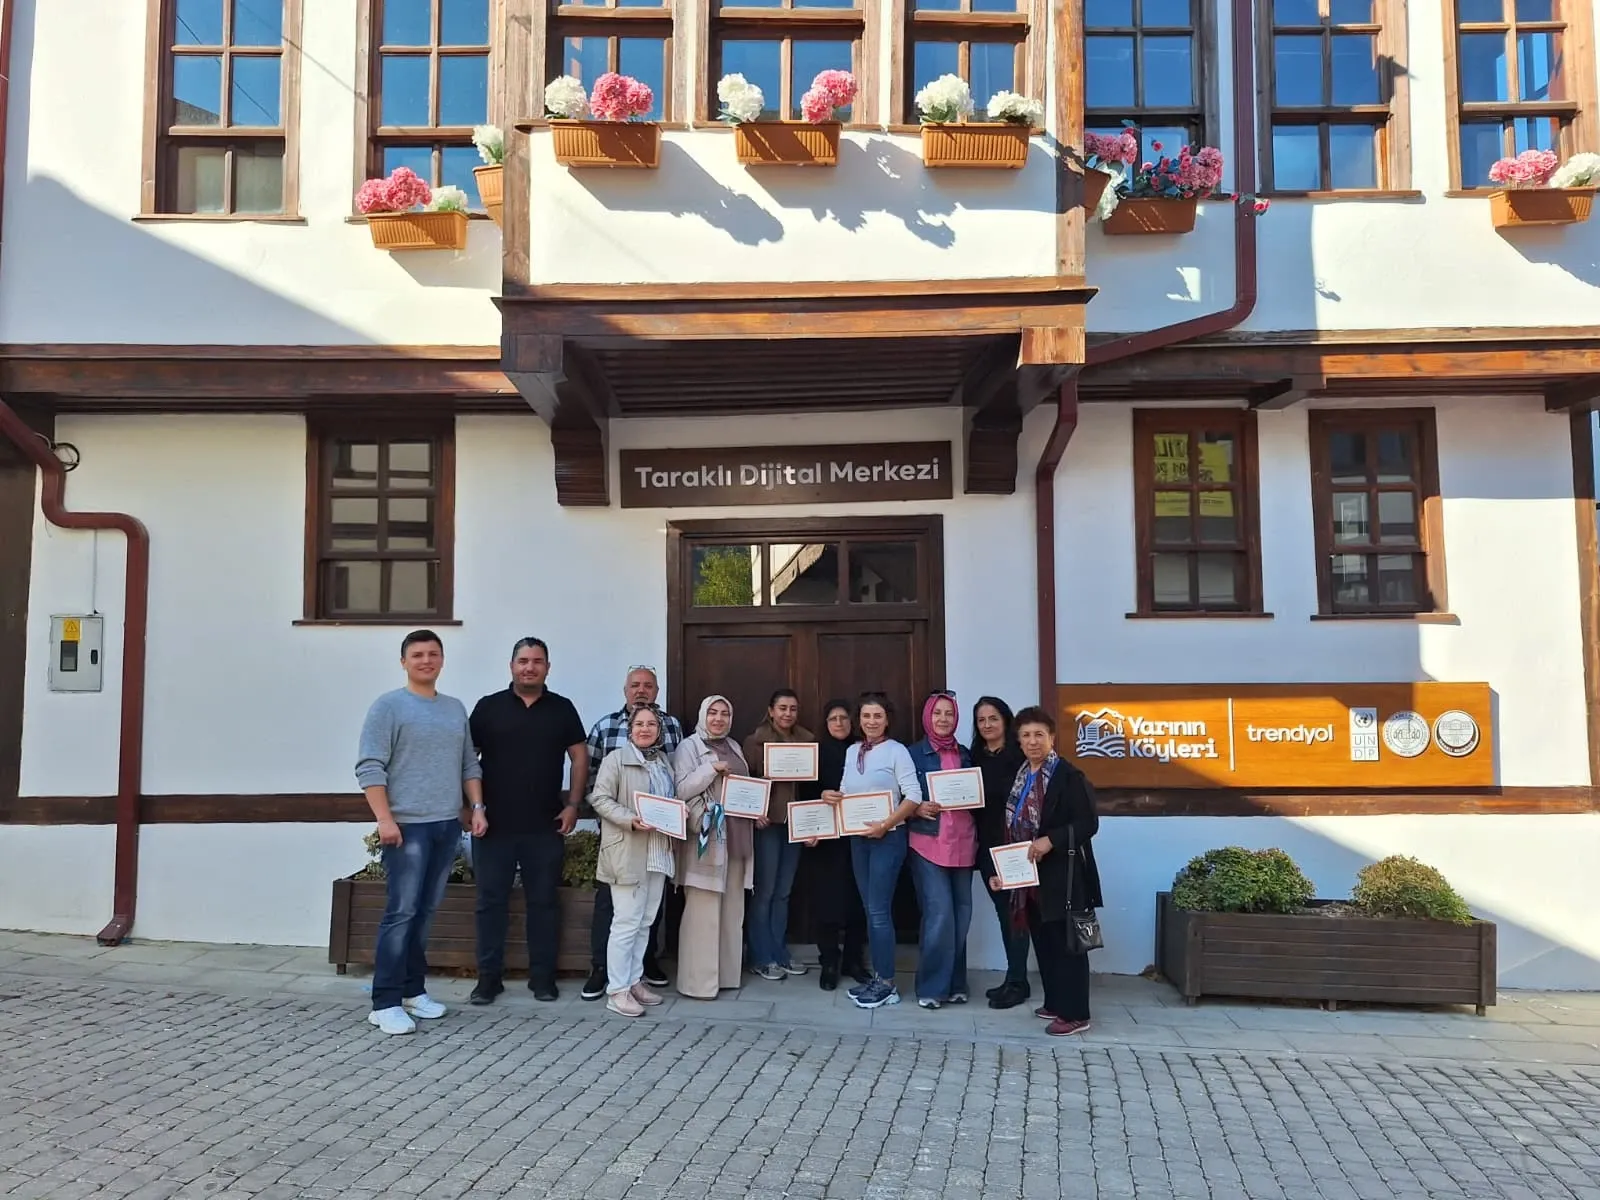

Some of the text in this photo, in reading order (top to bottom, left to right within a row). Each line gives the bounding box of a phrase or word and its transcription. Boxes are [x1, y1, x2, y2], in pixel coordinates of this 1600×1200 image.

[634, 457, 939, 490] Taraklı Dijital Merkezi
[1127, 716, 1207, 736] Yarının
[1246, 724, 1334, 745] trendyol
[1129, 738, 1219, 762] Köyleri
